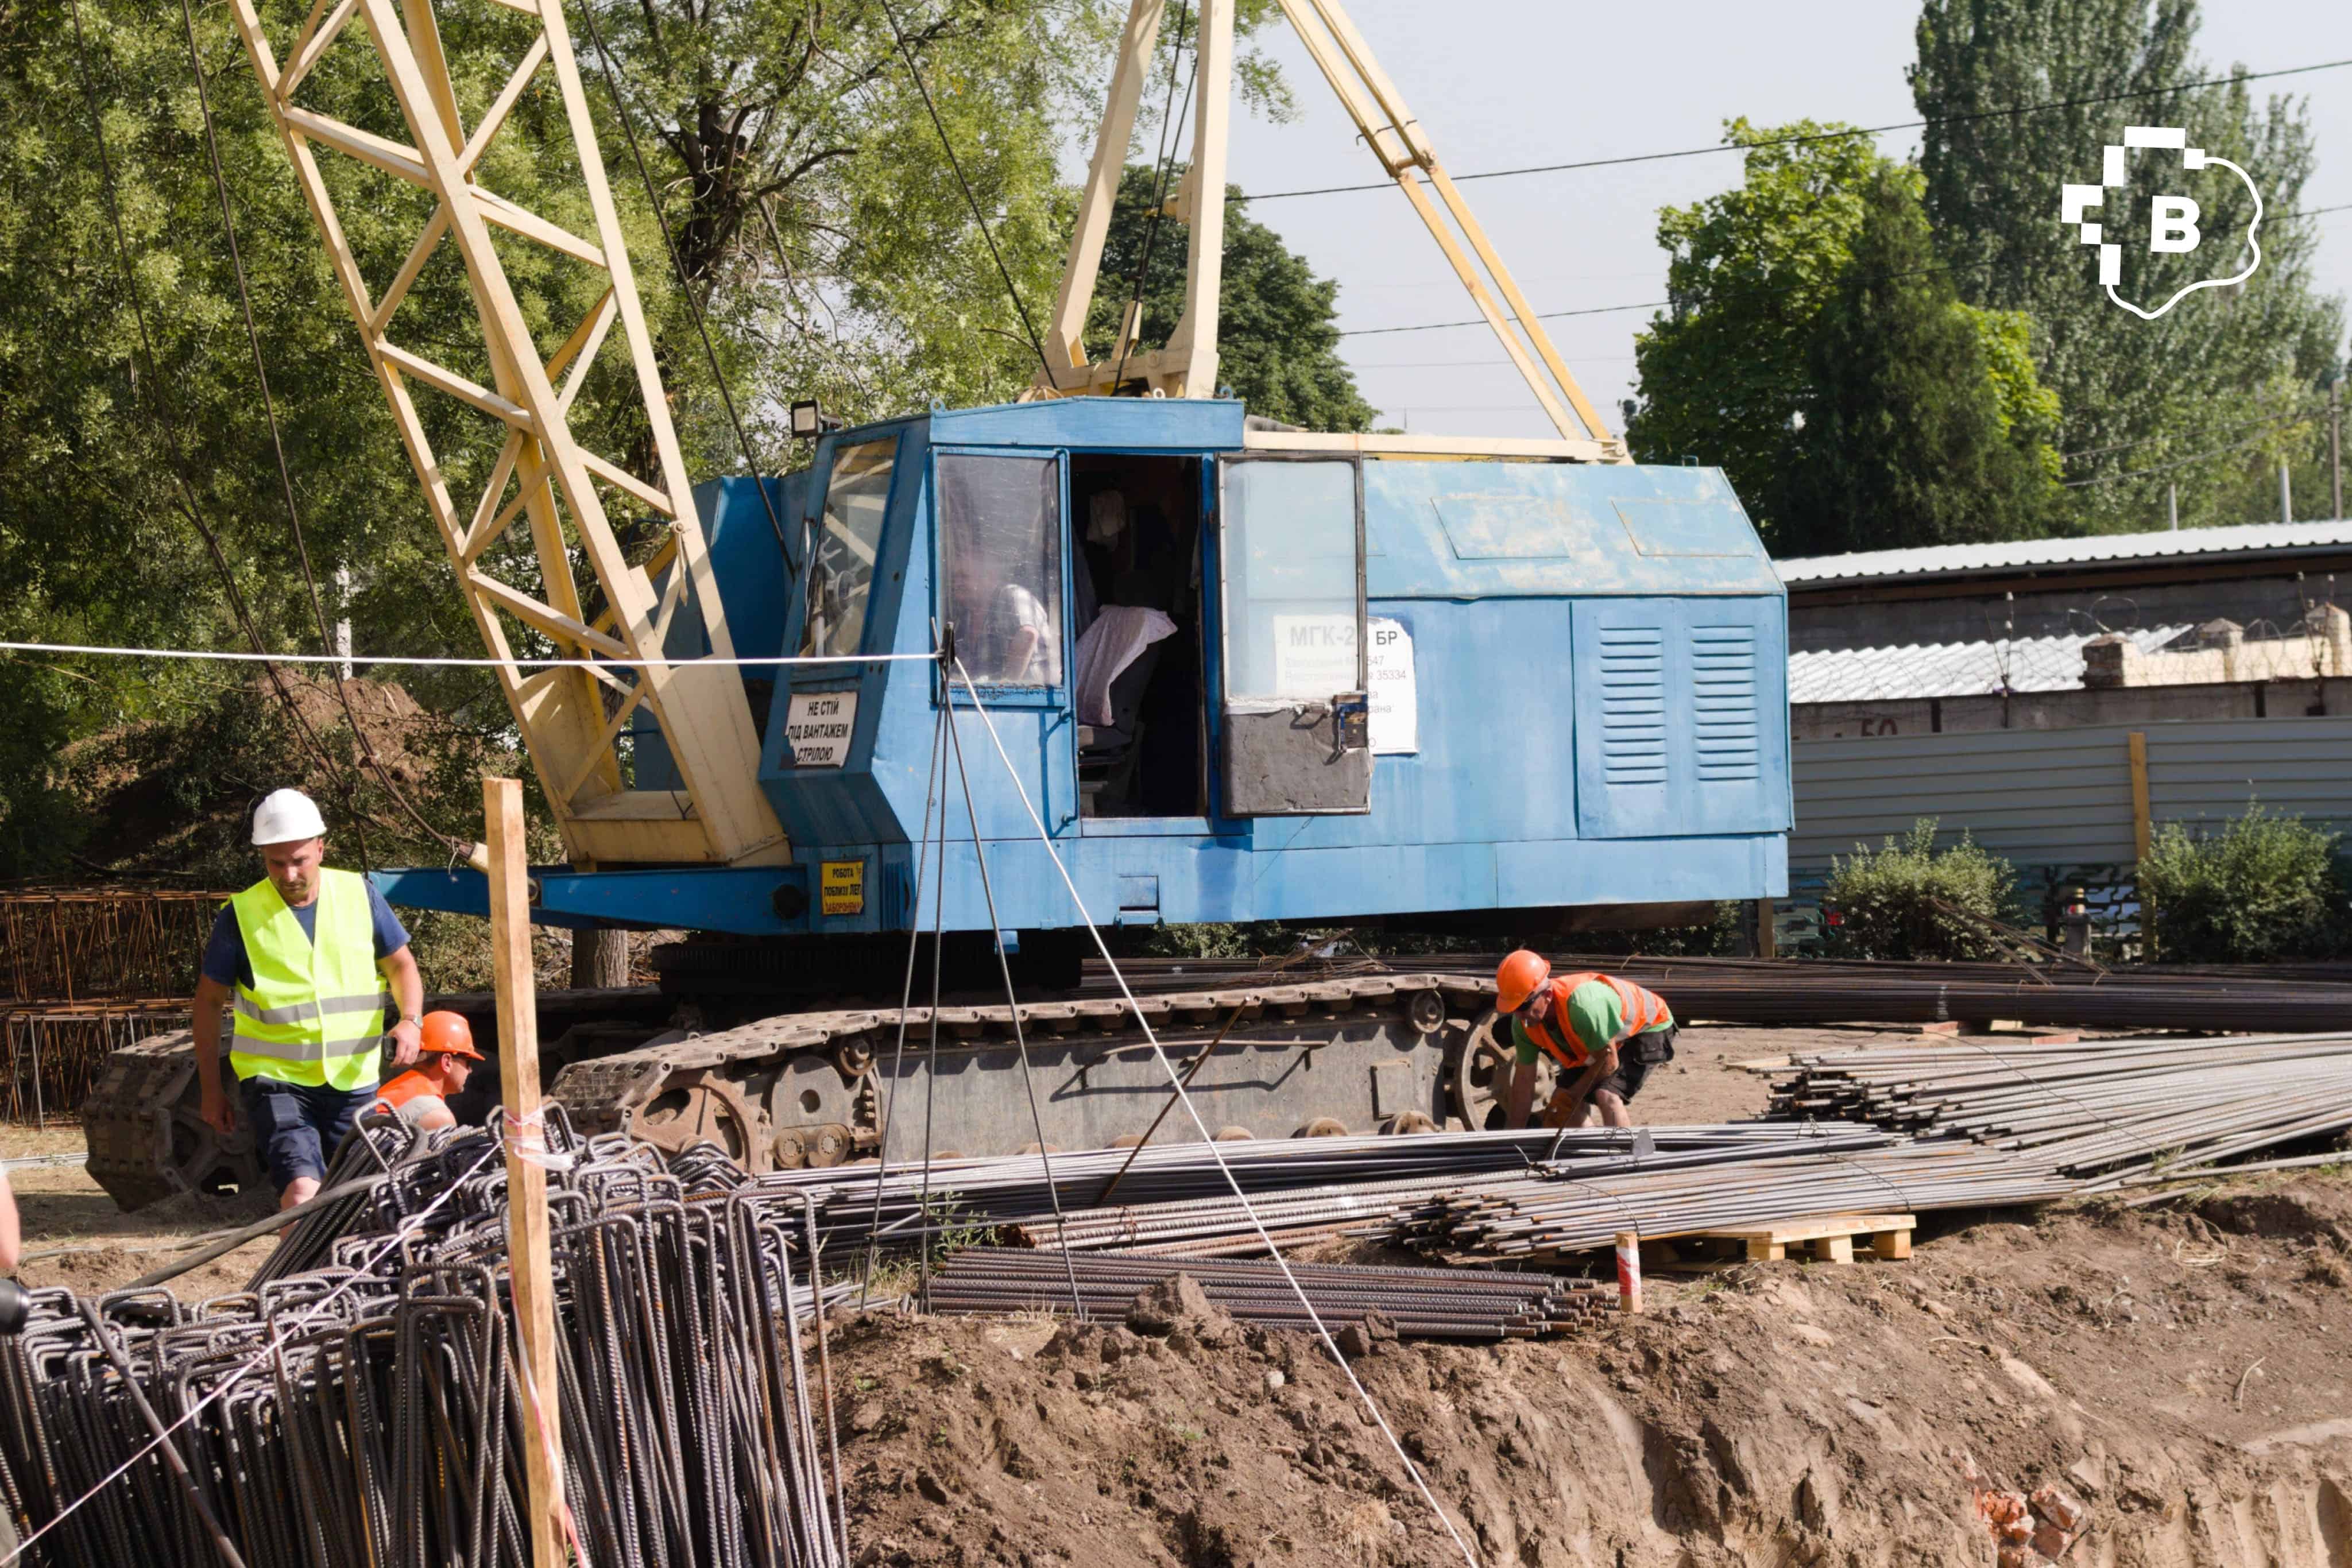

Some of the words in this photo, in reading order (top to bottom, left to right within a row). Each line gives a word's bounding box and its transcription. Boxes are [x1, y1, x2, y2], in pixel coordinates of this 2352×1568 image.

[1290, 625, 1356, 646] МГК-2
[807, 701, 819, 716] НЕ
[820, 698, 840, 716] СТІЙ
[790, 725, 802, 742] ПІД
[803, 723, 848, 739] ВАНТАЖЕМ
[797, 746, 833, 762] СТРІЛОЮ
[832, 868, 854, 878] РОБОТА
